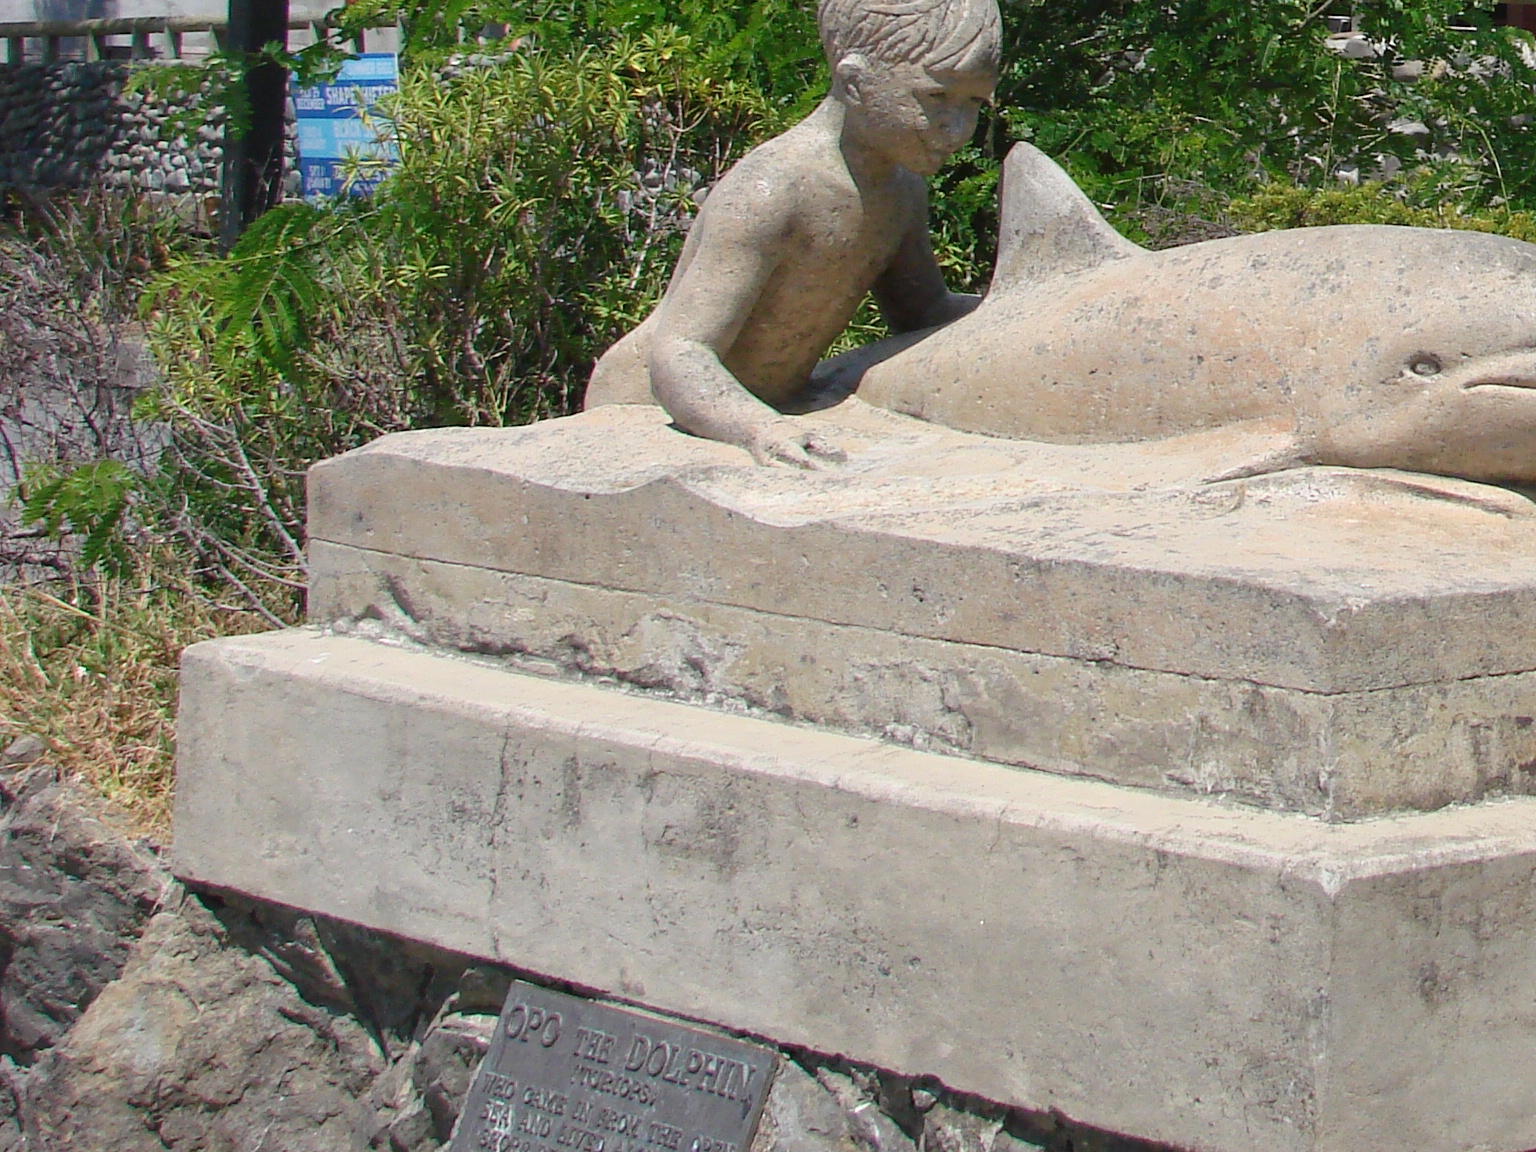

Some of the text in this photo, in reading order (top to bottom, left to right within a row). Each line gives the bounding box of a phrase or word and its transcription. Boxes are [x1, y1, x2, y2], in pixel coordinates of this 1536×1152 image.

[504, 1003, 757, 1102] OPO THE DOLPHIN
[523, 1085, 567, 1116] CAME
[648, 1121, 684, 1150] THE
